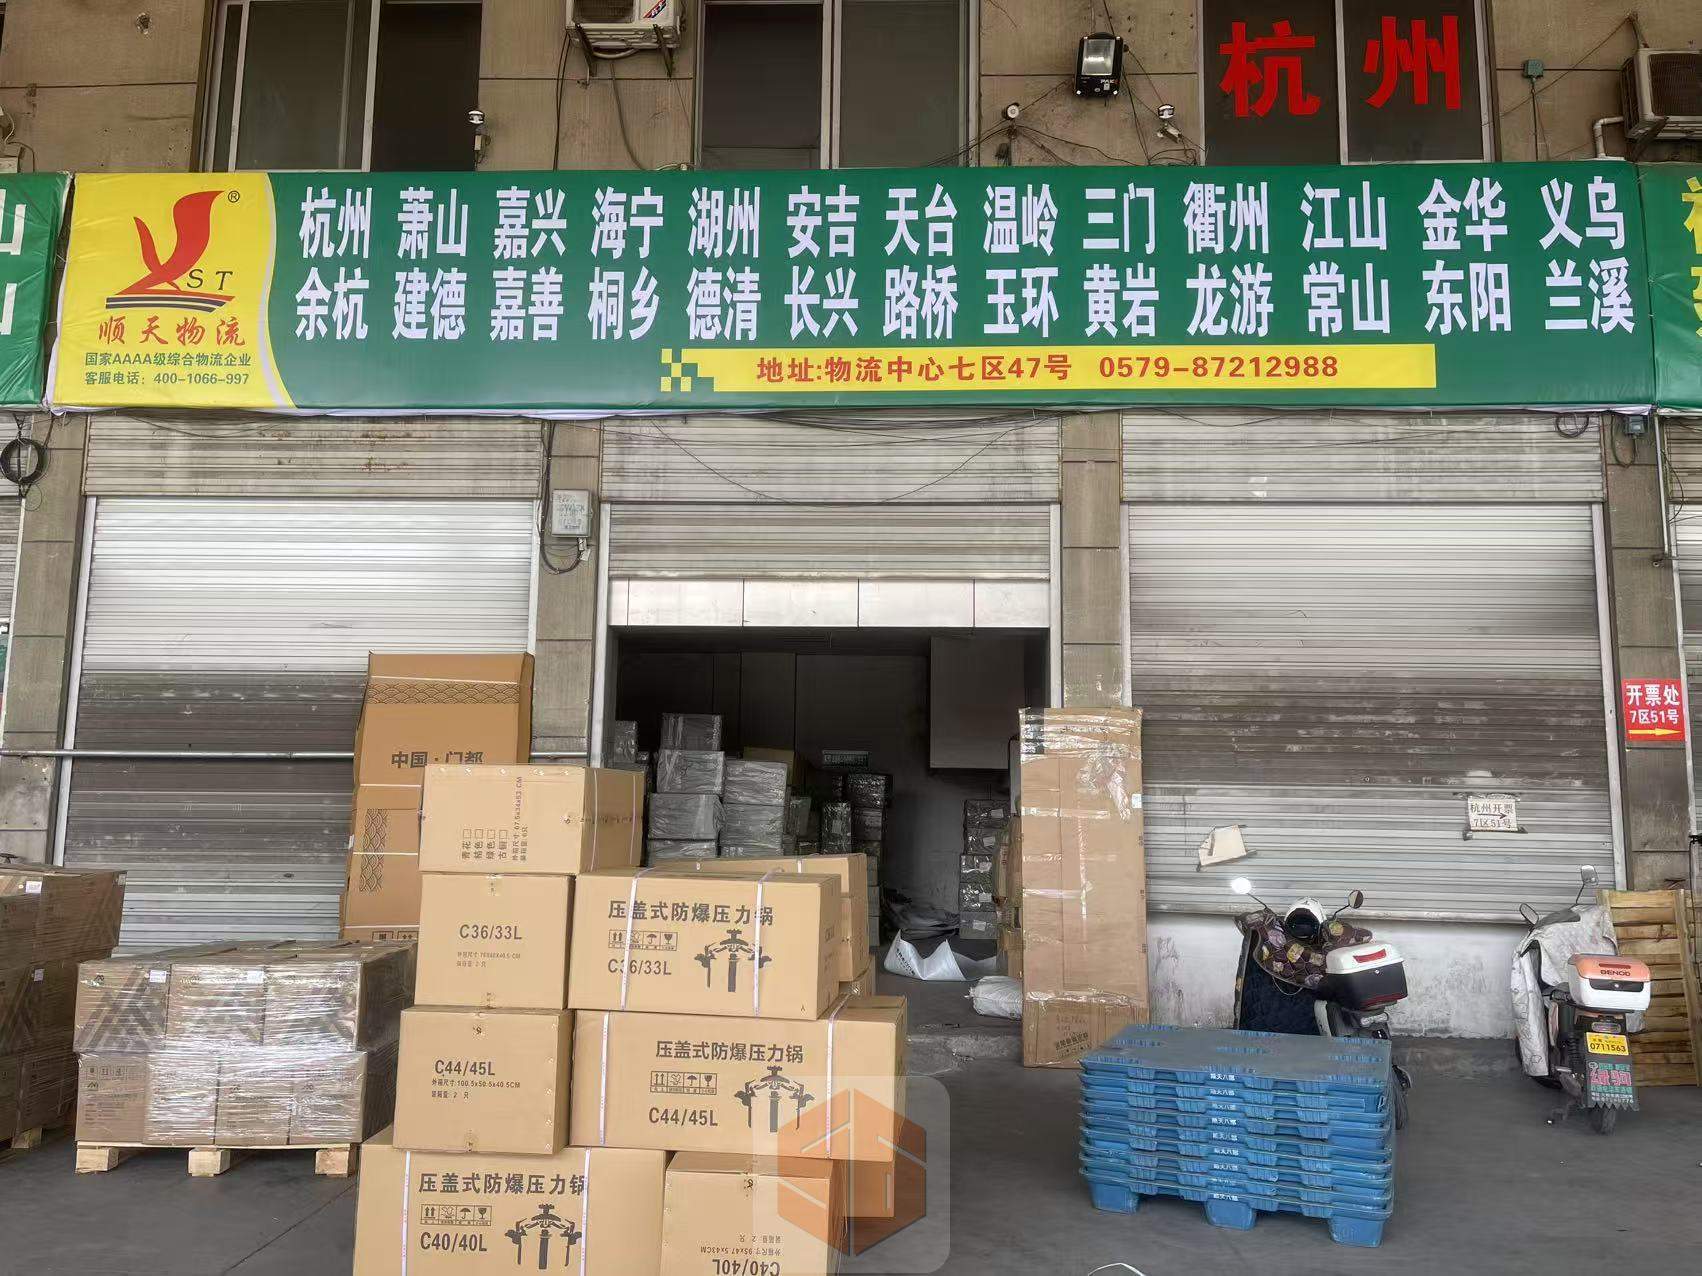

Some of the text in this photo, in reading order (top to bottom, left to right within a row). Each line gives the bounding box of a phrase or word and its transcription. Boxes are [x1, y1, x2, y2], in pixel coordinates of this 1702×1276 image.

[1220, 17, 1461, 117] 杭州
[299, 187, 372, 258] 杭州
[398, 187, 468, 259] 萧山
[493, 186, 566, 259] 嘉兴
[591, 187, 663, 259] 海宁
[688, 187, 760, 258] 湖州
[787, 185, 859, 258] 安吉
[885, 184, 957, 256] 天台
[984, 184, 1058, 255] 温岭
[1083, 183, 1155, 254] 三门
[1183, 182, 1268, 254] 衢州
[1301, 181, 1386, 251] 江山
[1418, 178, 1507, 251] 金华
[1540, 176, 1624, 249] 义乌
[295, 267, 369, 340] 余杭
[392, 267, 467, 339] 建德
[490, 266, 563, 341] 嘉善
[588, 266, 659, 340] 桐乡
[686, 266, 761, 340] 德清
[784, 266, 858, 340] 长兴
[883, 265, 958, 339] 路桥
[984, 267, 1059, 337] 玉环
[1084, 263, 1159, 337] 黄岩
[1187, 262, 1273, 337] 龙游
[1303, 261, 1390, 337] 常山
[1423, 260, 1511, 335] 东阳
[1546, 257, 1635, 333] 兰溪
[99, 316, 245, 346] 顺天物流
[85, 352, 251, 367] 国家AAAA级综合物流企业
[757, 355, 1336, 382] 地址:物流中心七区47号 0579-87212988
[1626, 683, 1680, 706] 开票处
[1629, 708, 1679, 724] 7区51号
[1471, 803, 1514, 814] 杭州开票
[608, 900, 774, 927] 压盖式防爆压力锅
[460, 924, 522, 940] C36/33L
[656, 1040, 803, 1064] 压盖式防爆压力锅
[1590, 1043, 1626, 1053] 0711563
[435, 1059, 495, 1076] C44/45L
[649, 1106, 718, 1126] C44/45L
[419, 1173, 586, 1195] 压盖式防爆压力锅
[420, 1231, 487, 1252] C40/40L
[712, 1258, 780, 1276] C40/40L
